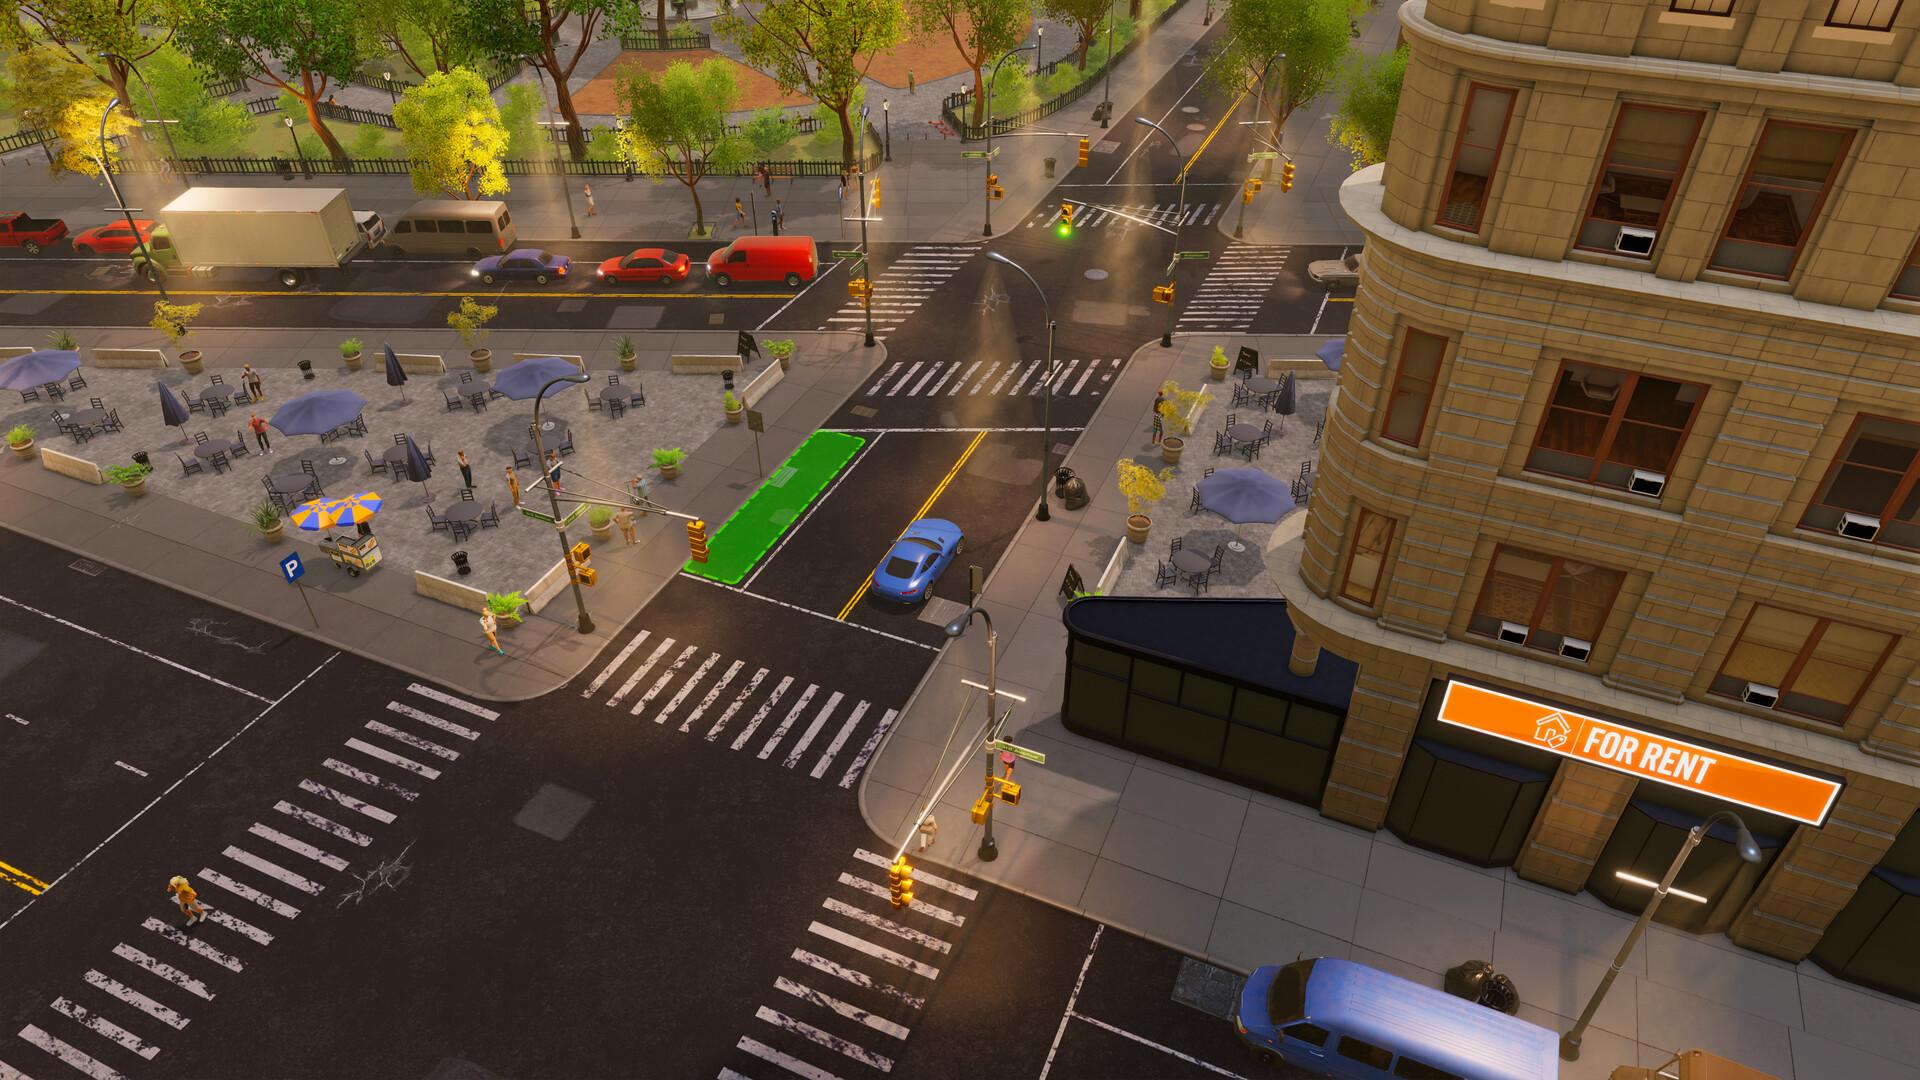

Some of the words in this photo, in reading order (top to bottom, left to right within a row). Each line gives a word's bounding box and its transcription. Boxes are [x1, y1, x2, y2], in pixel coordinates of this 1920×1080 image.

[285, 560, 298, 578] P
[1583, 727, 1639, 765] FOR
[1639, 742, 1717, 785] RENT
